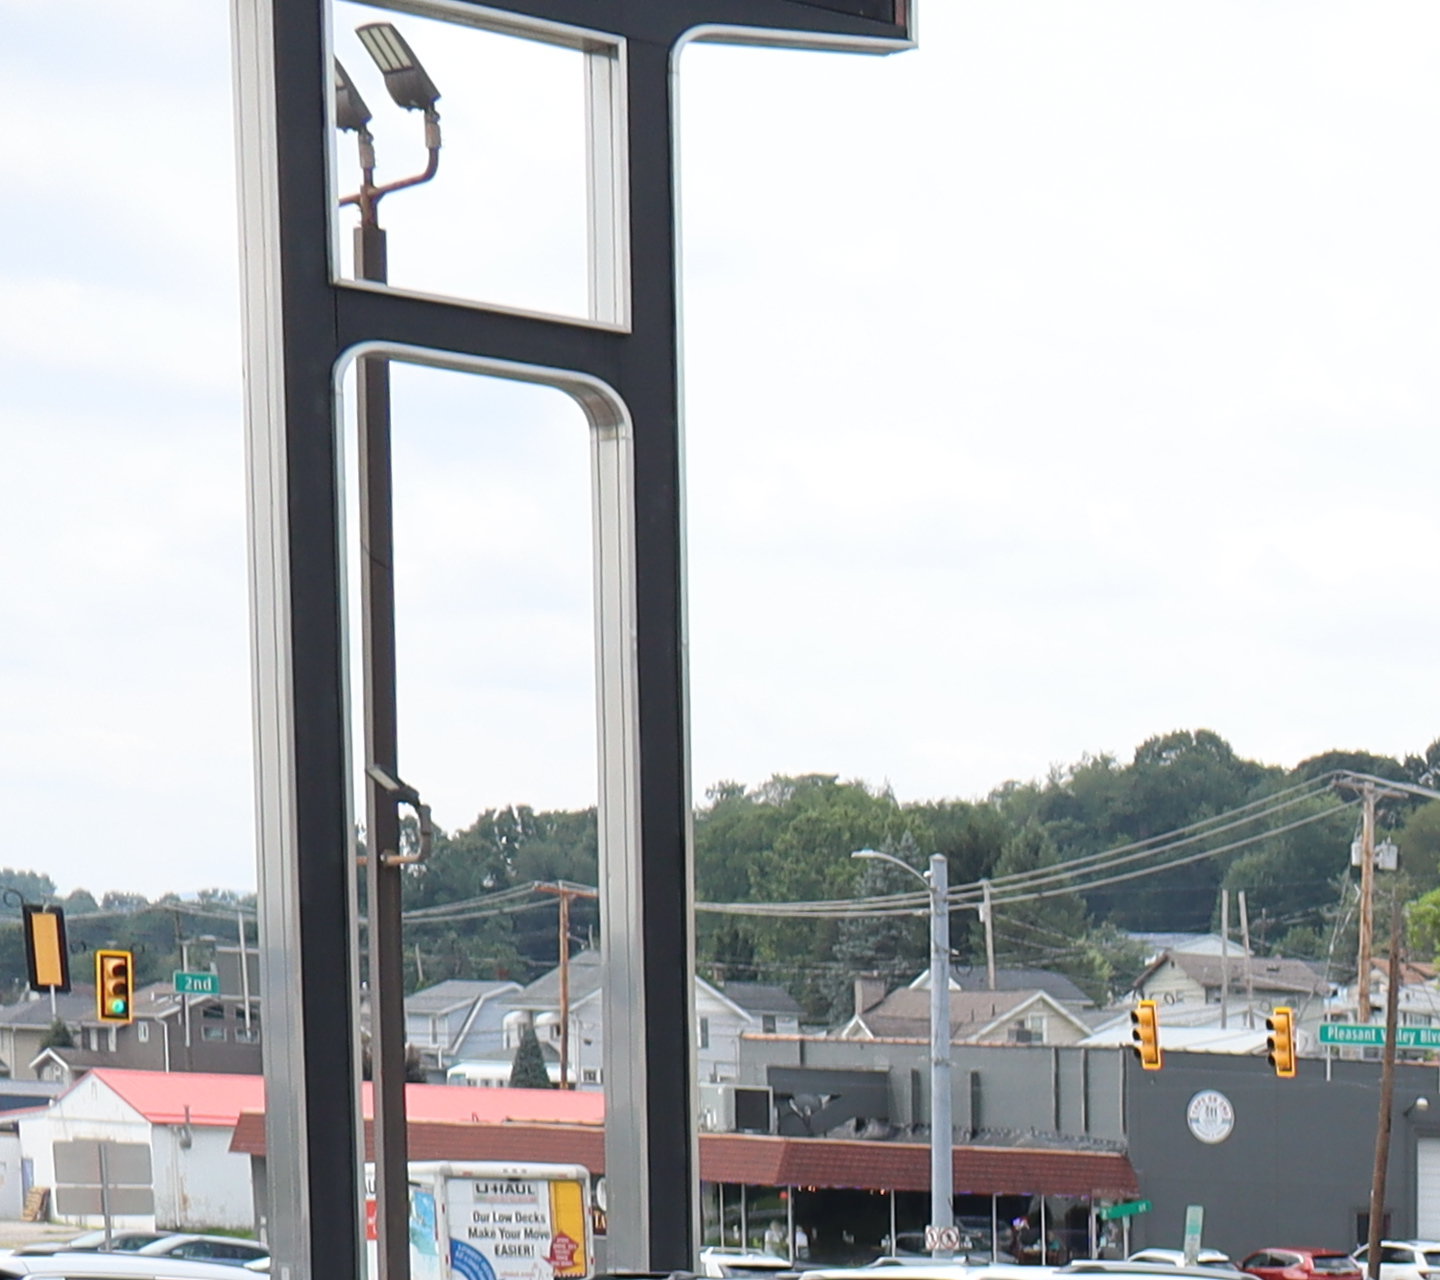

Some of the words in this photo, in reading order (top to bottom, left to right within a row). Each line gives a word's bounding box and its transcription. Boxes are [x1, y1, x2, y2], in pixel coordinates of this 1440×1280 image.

[184, 975, 212, 991] 2nd
[1328, 1026, 1376, 1041] Pleasant
[473, 1211, 490, 1223] Our
[493, 1211, 512, 1223] Low
[515, 1211, 546, 1223] Decks
[468, 1227, 496, 1239] Make
[499, 1227, 521, 1240] Your
[524, 1227, 551, 1240] Move
[494, 1244, 535, 1257] EASIER!
